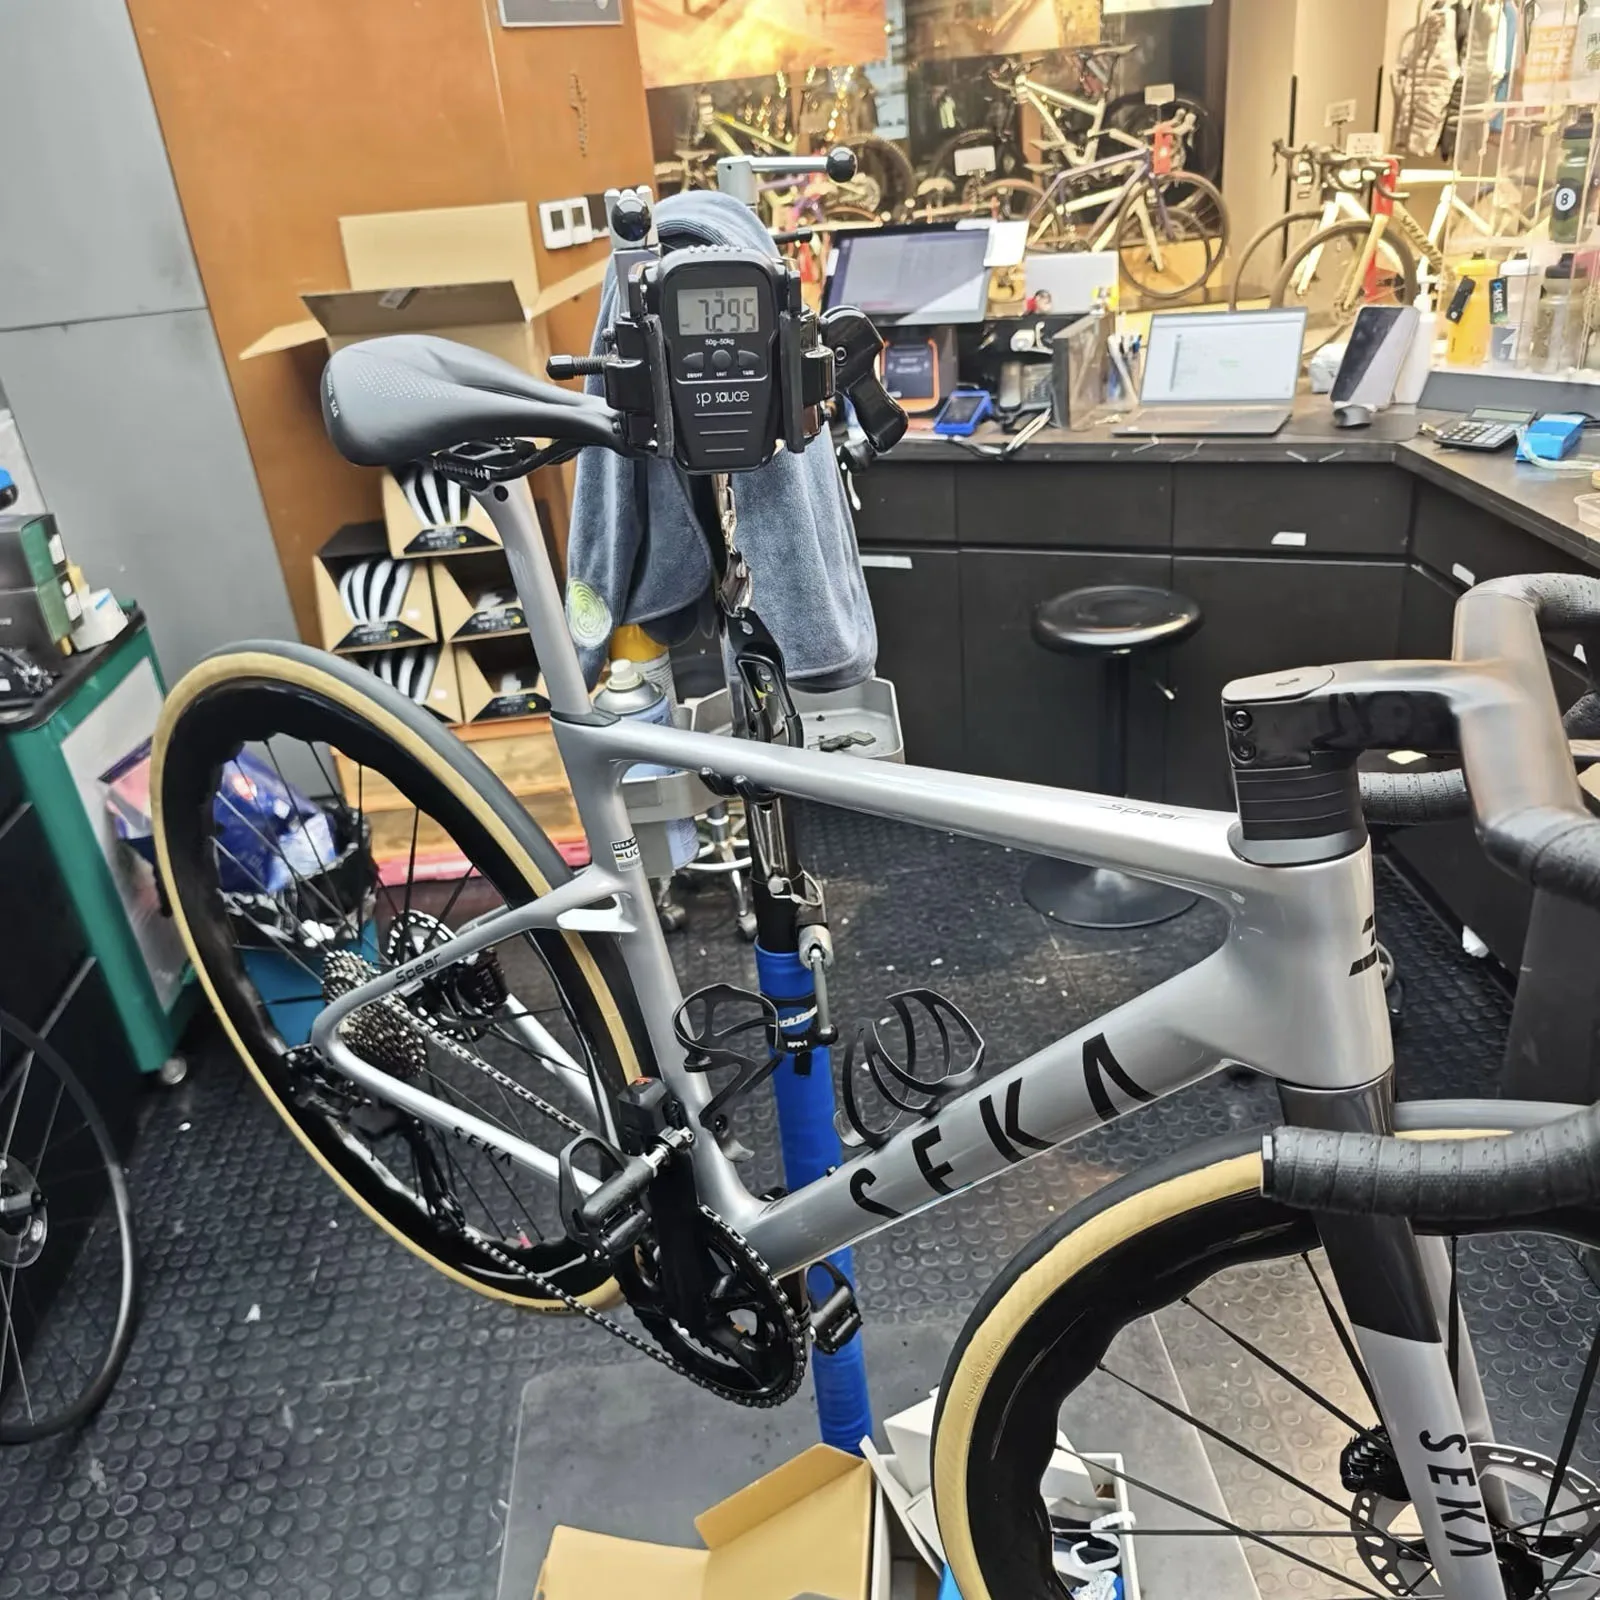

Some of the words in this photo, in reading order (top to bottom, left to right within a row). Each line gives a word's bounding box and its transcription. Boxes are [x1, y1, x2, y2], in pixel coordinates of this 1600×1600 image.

[1560, 192, 1569, 206] 8
[696, 392, 711, 407] sp
[715, 390, 750, 403] sauce
[394, 953, 441, 987] Spear
[1419, 1429, 1493, 1557] SEKA
